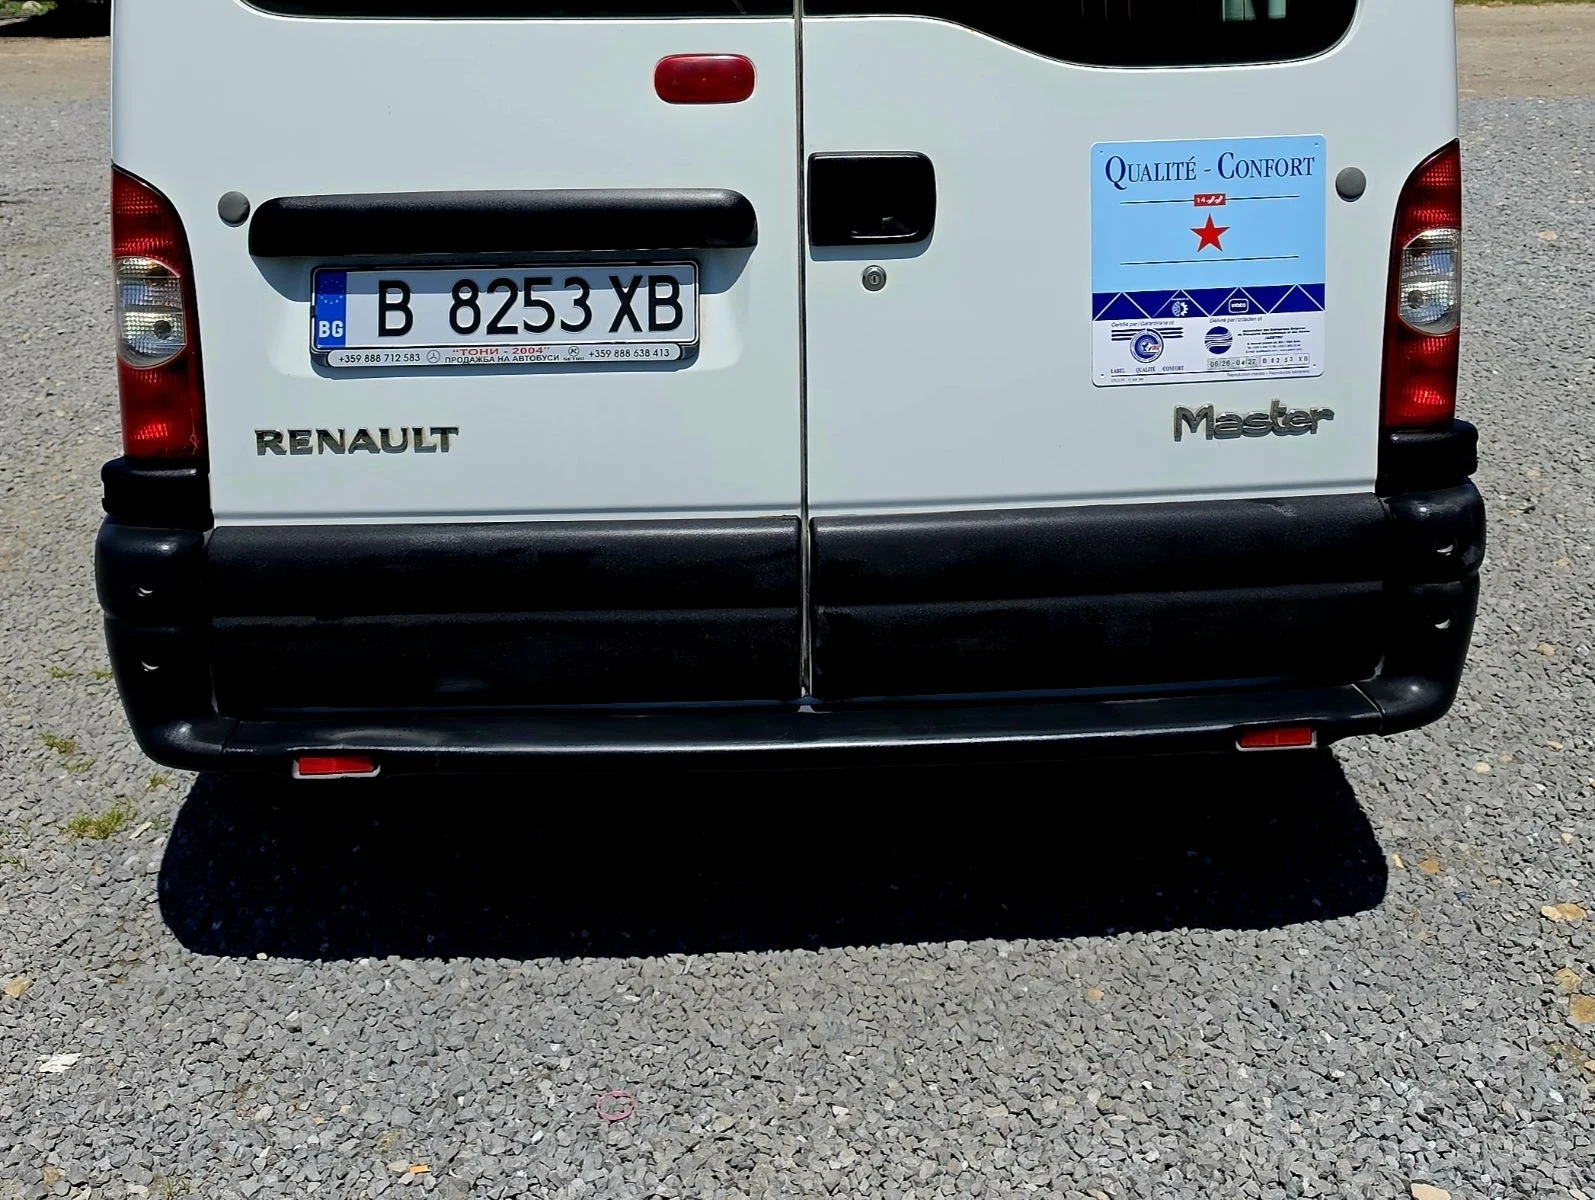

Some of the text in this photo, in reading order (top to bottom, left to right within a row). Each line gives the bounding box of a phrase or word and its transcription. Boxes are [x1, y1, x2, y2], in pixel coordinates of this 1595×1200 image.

[1105, 155, 1197, 190] QUALITÉ
[1218, 151, 1315, 179] CONFORT
[378, 275, 684, 337] B 8253 XB
[318, 320, 344, 338] BG
[338, 353, 420, 363] +359 888 712 583
[445, 356, 495, 364] ПРОДАЖБА
[589, 348, 669, 358] +359 888 638 413
[1174, 398, 1335, 442] Master
[254, 425, 459, 456] RENAULT
